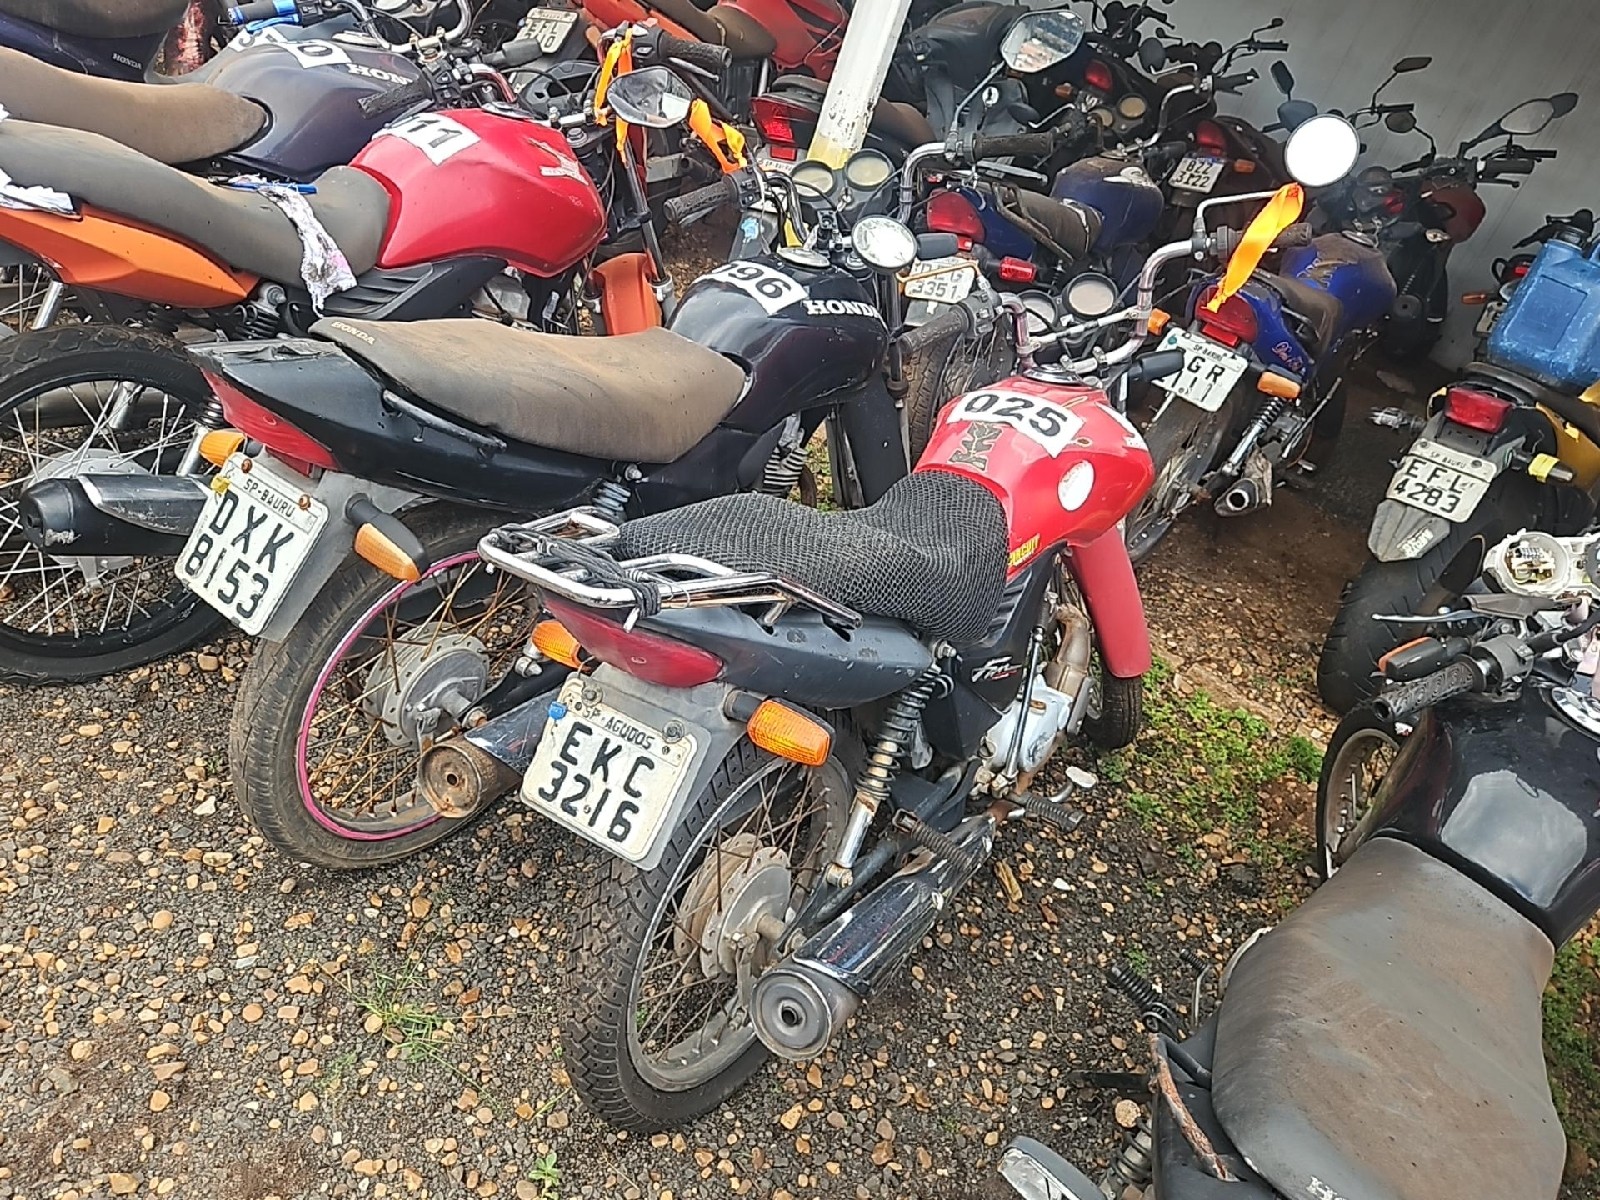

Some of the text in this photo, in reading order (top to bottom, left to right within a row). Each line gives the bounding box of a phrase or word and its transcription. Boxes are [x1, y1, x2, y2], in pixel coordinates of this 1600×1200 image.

[112, 52, 142, 70] HONDA
[346, 63, 413, 84] HON
[406, 117, 463, 148] 11
[911, 279, 958, 299] 3351
[331, 321, 375, 345] HONDA
[1180, 350, 1226, 383] GR
[964, 393, 1068, 437] 025
[1406, 458, 1462, 494] EFL
[1394, 478, 1461, 513] 4283
[209, 488, 295, 574] DXK
[185, 533, 269, 619] 8153
[559, 721, 655, 799] EKC
[538, 760, 639, 843] 3216
